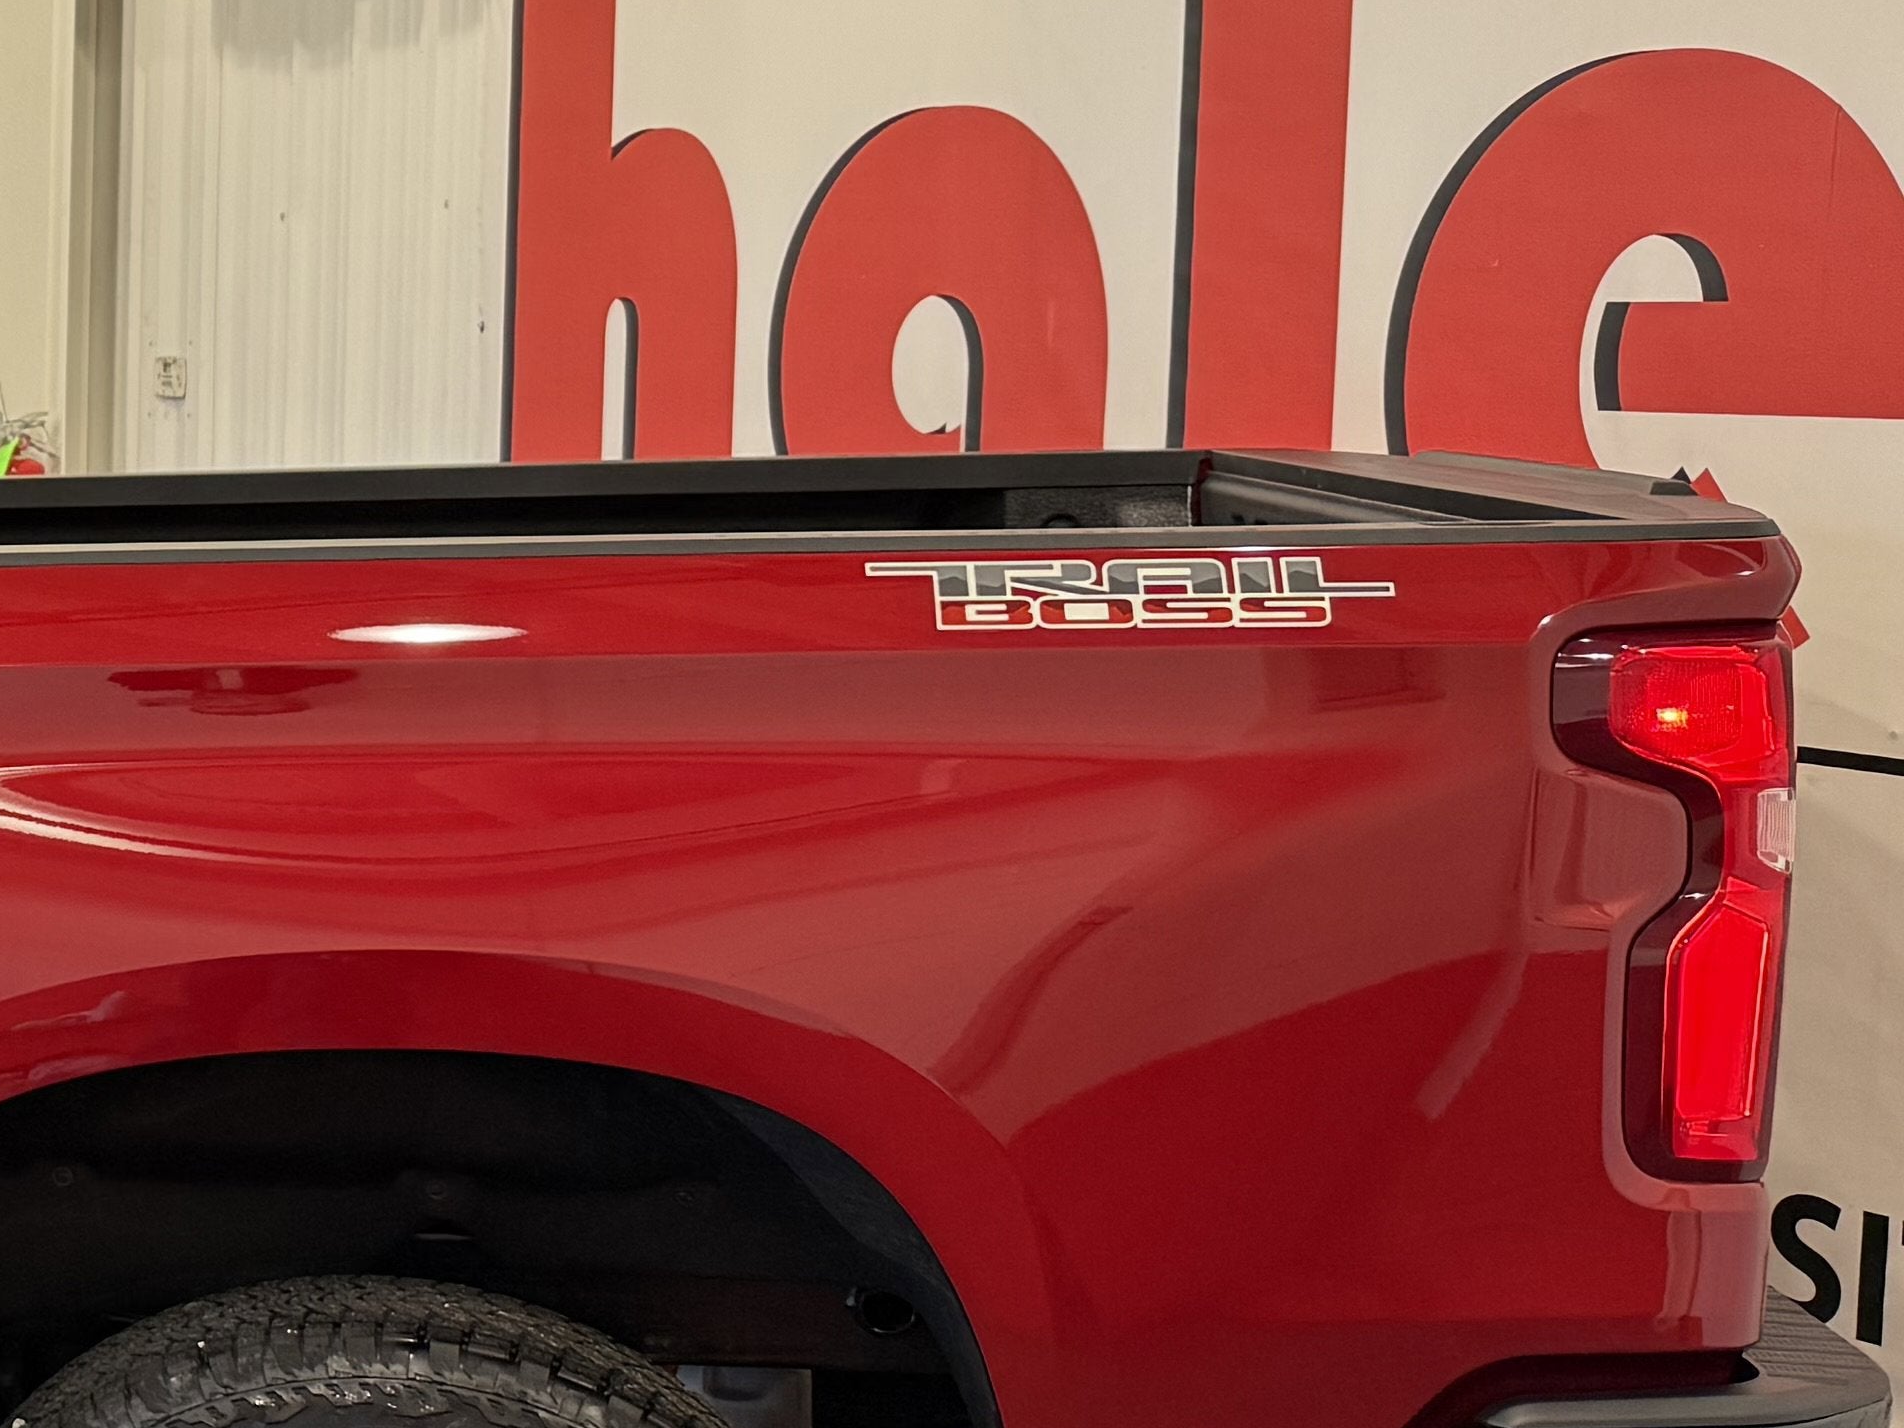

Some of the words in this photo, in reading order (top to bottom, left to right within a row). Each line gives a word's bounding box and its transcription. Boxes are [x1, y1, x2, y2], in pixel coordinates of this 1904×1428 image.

[865, 557, 1395, 597] TRAIL
[937, 593, 1332, 630] BOSS
[1771, 1193, 1904, 1347] SI
